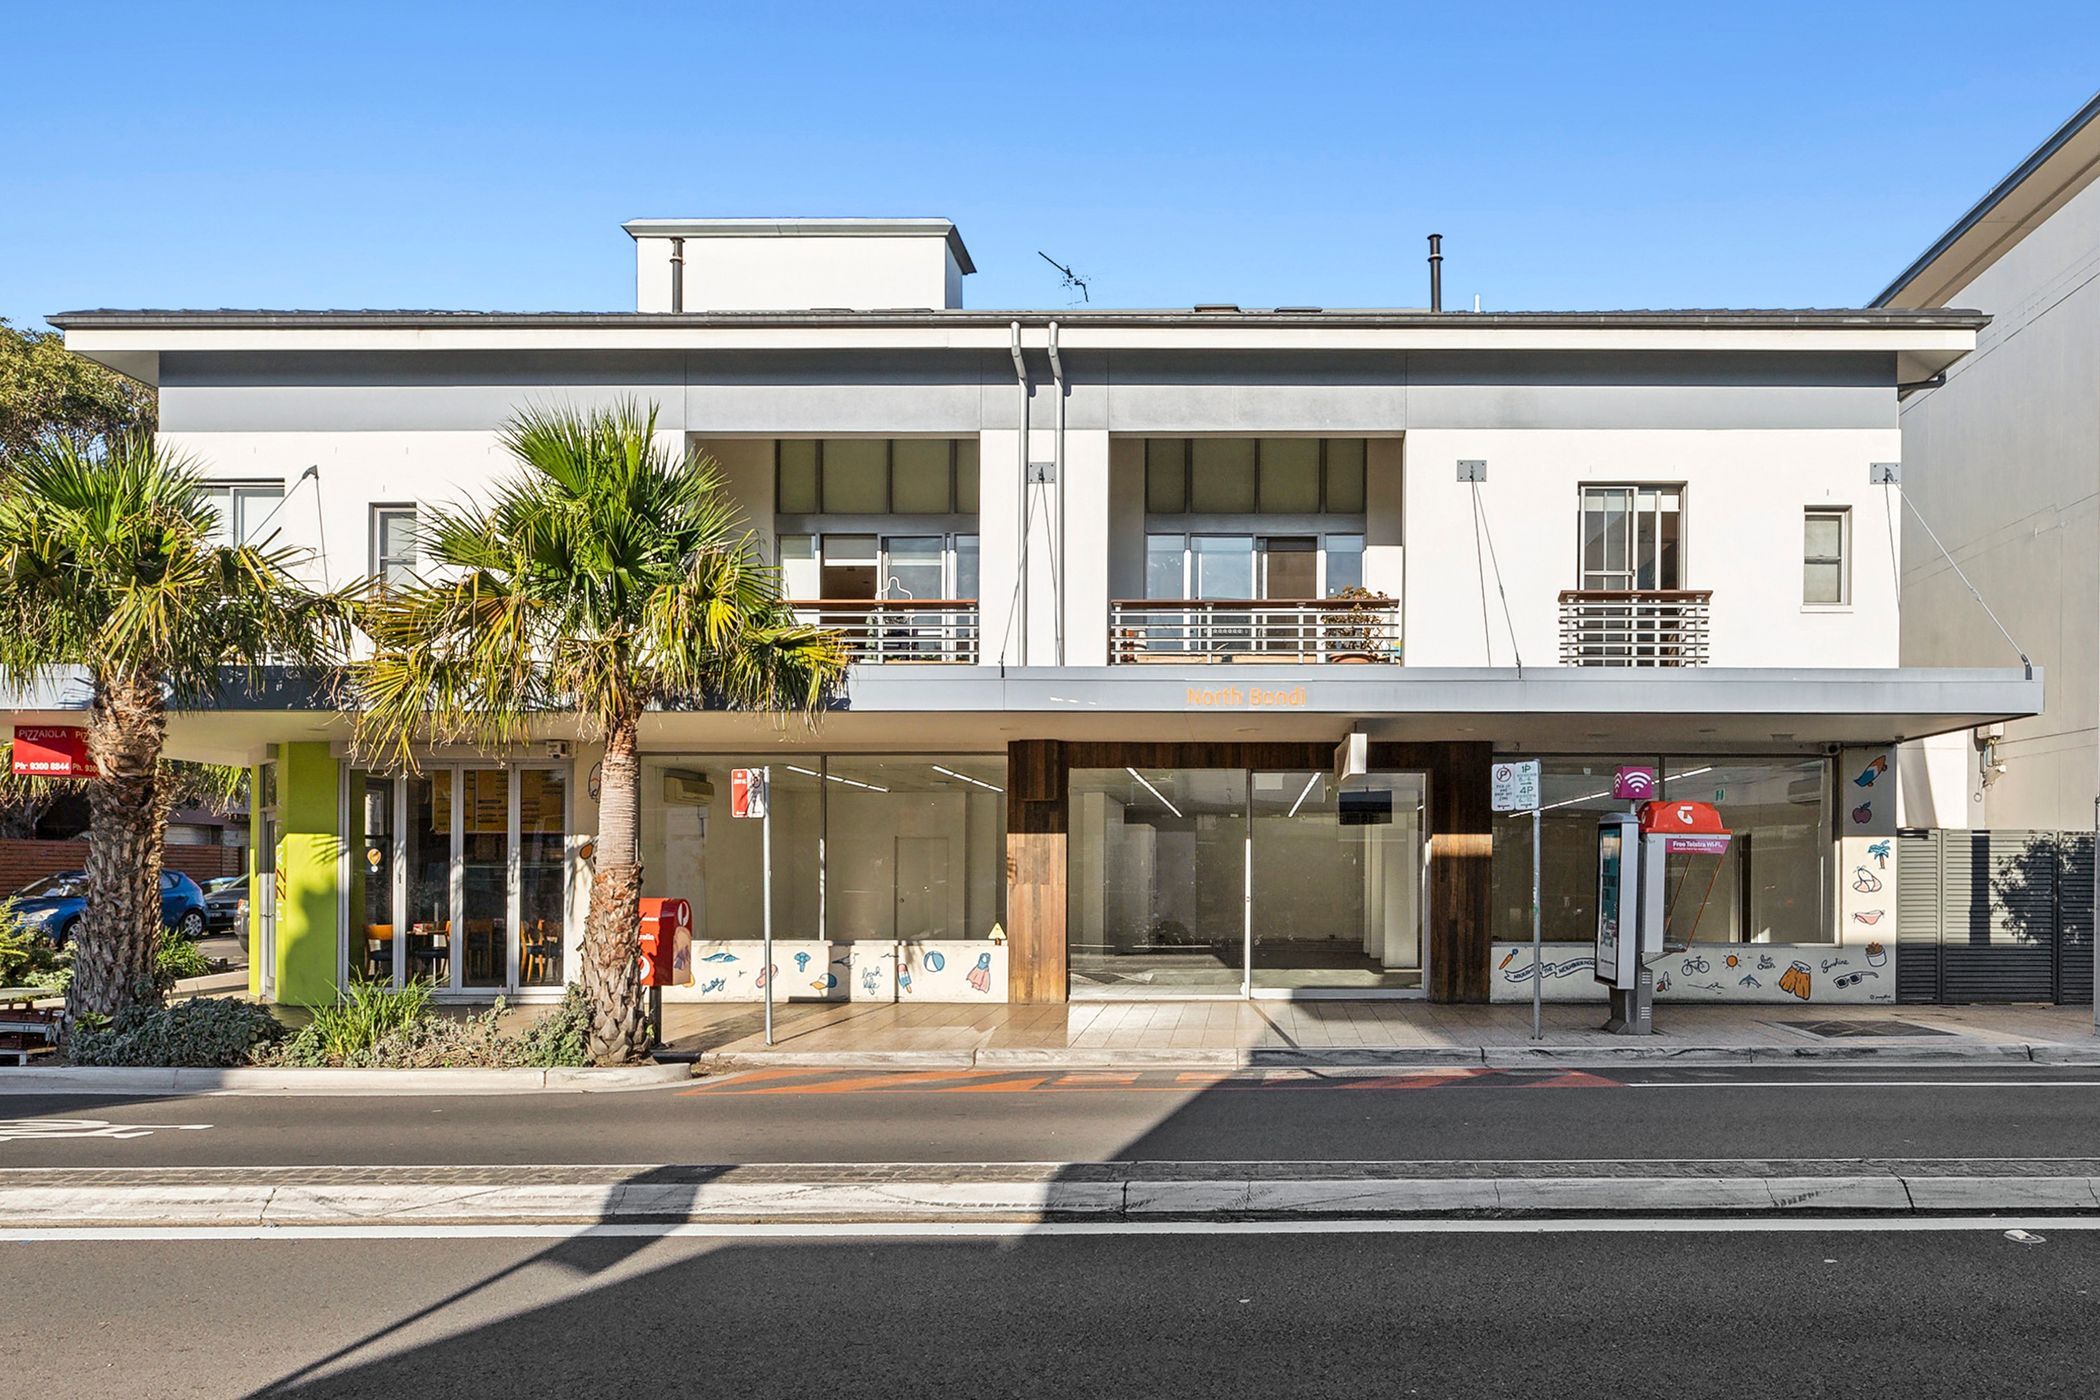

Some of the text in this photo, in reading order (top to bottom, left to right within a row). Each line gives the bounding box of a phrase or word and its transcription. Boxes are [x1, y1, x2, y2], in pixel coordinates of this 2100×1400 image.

[1187, 686, 1307, 705] North Bondi
[18, 729, 67, 741] PIZZAIOLA
[1672, 840, 1686, 848] Free
[1686, 840, 1706, 848] Telstra
